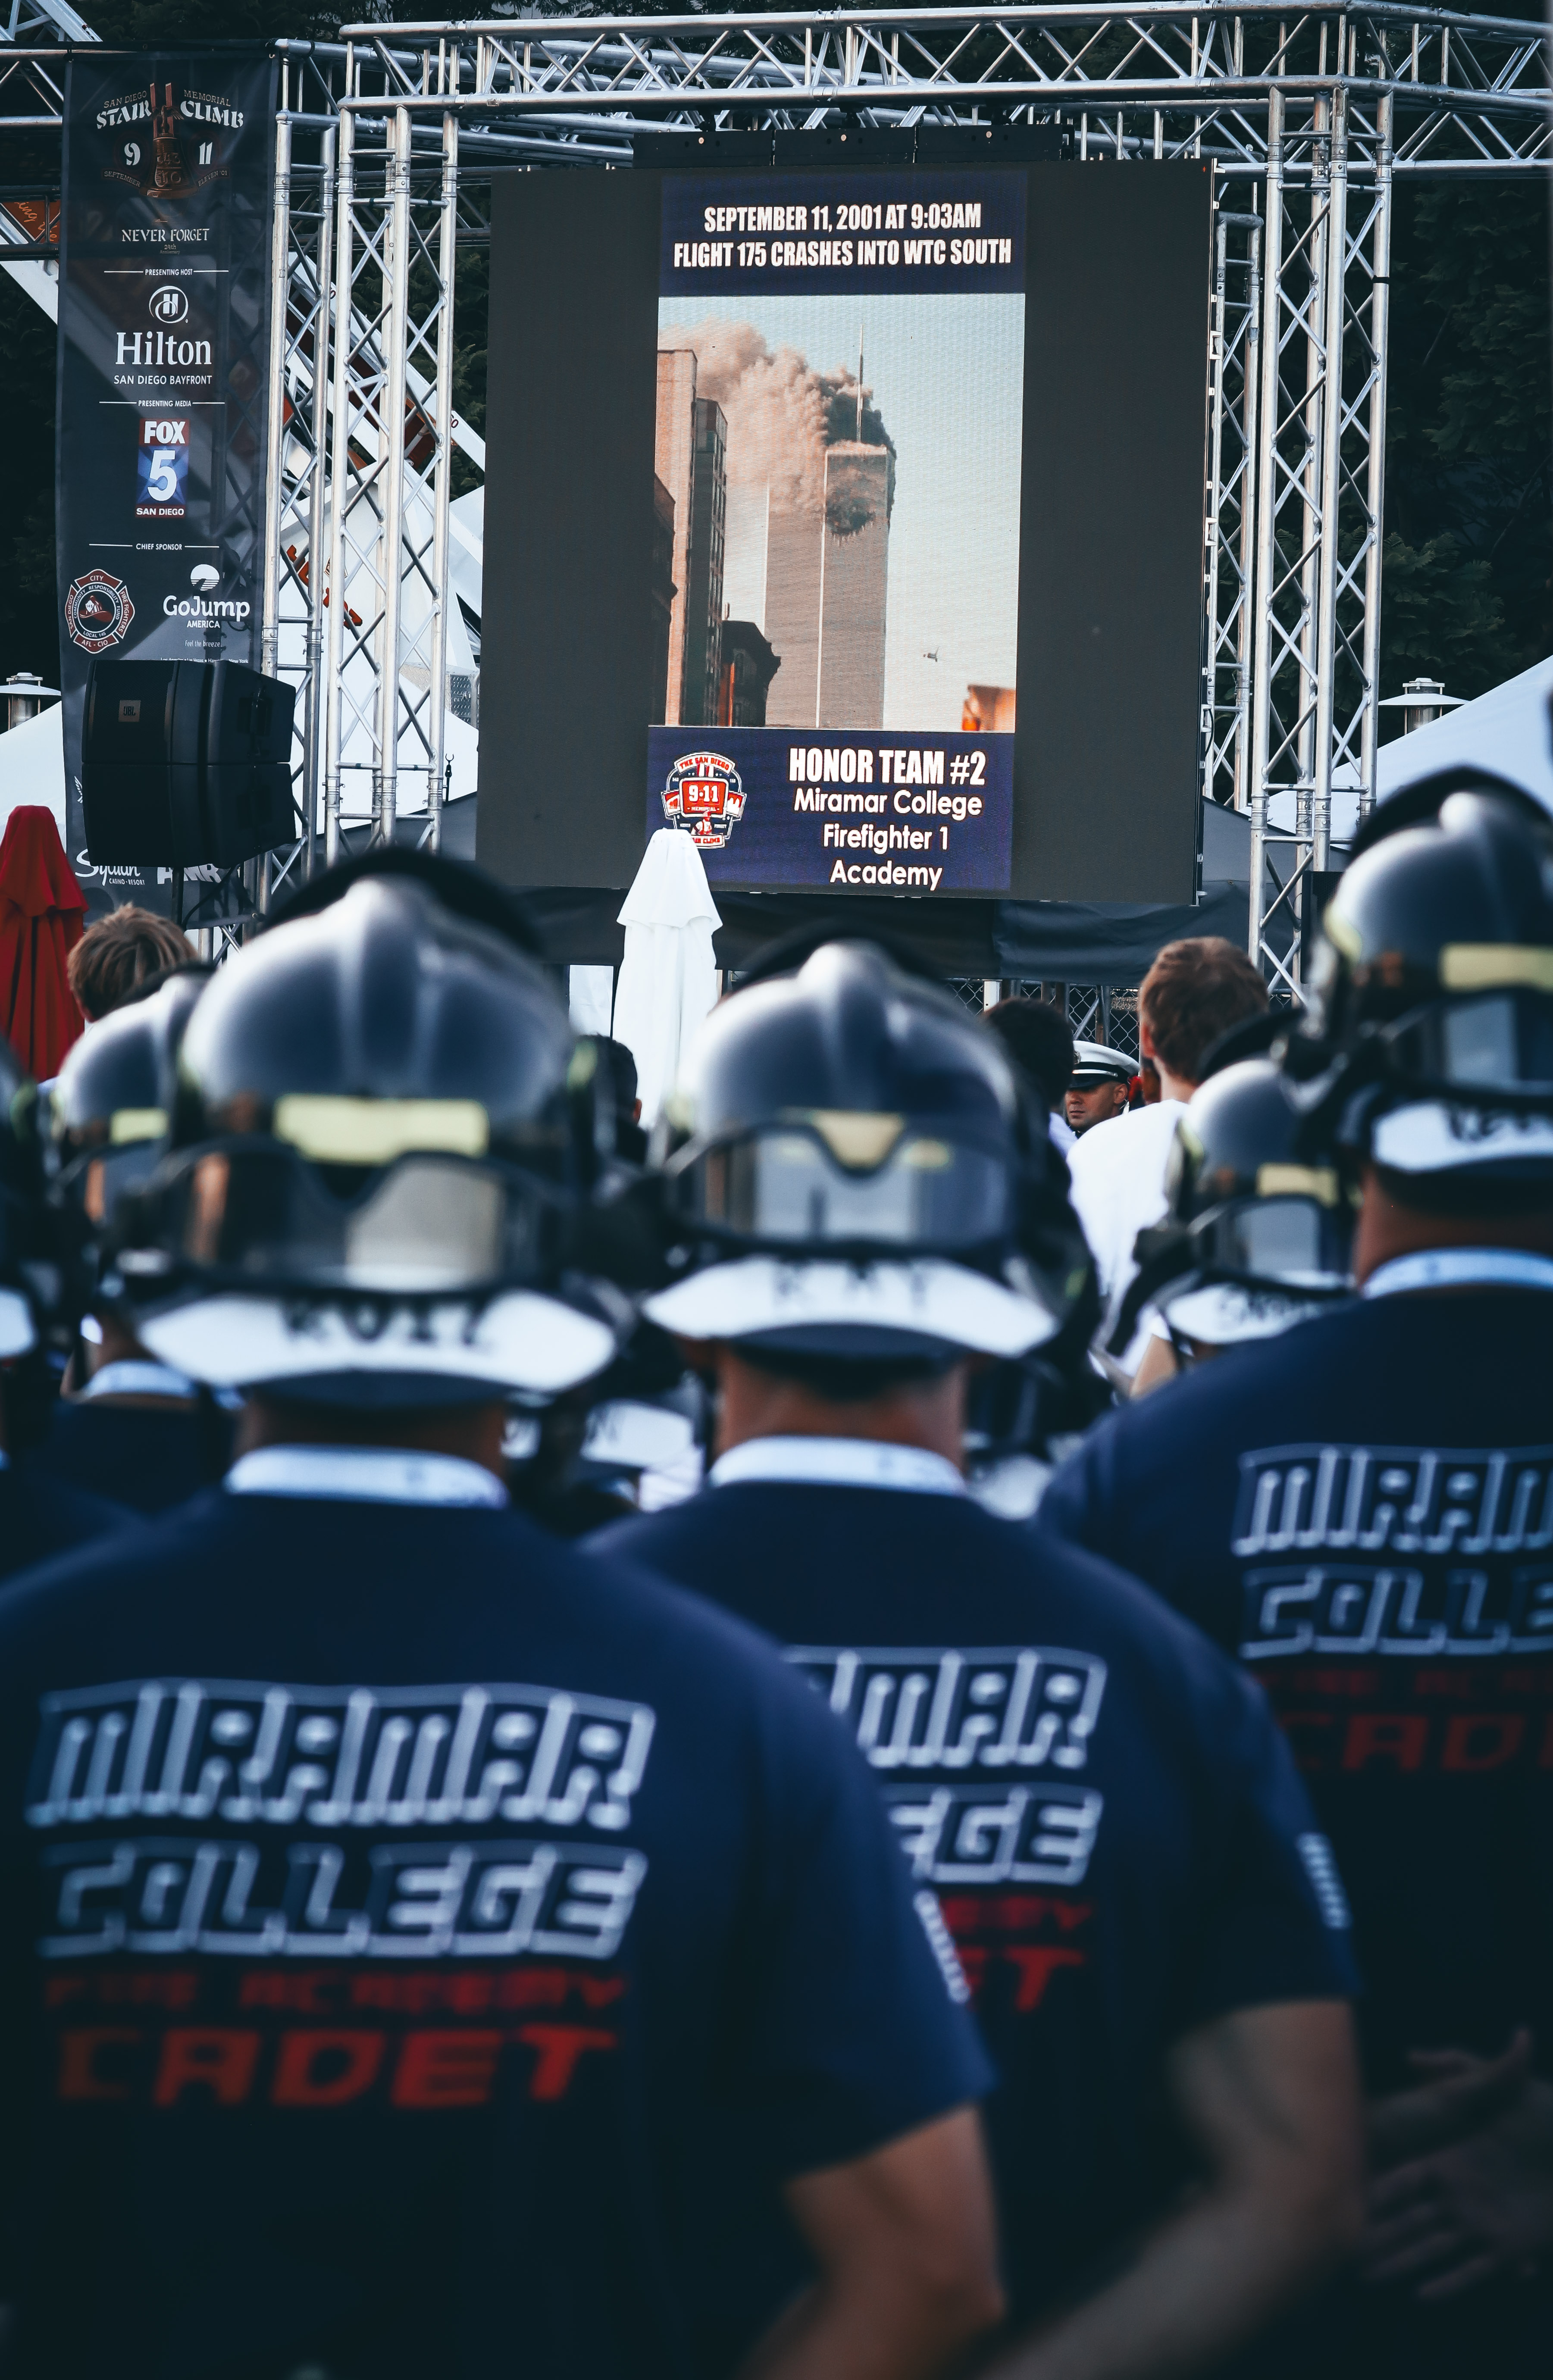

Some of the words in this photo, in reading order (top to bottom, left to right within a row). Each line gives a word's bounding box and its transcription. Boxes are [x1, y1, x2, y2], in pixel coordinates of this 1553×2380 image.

[104, 97, 122, 109] SAN
[124, 91, 147, 103] DIEGO
[184, 89, 231, 106] MEMORIAL
[96, 100, 152, 129] STAIR
[180, 100, 244, 128] CLIMB
[124, 143, 141, 166] 9
[199, 142, 213, 165] 11
[103, 171, 141, 187] SEPTEMBER
[198, 171, 219, 187] ELEVEN
[704, 206, 807, 232] SEPTEMBER
[811, 206, 832, 233] 11,
[836, 204, 882, 231] 2001
[885, 204, 907, 229] AT
[911, 203, 981, 229] 9:03AM
[121, 229, 167, 242] NEVER
[170, 228, 210, 241] FORGET
[674, 242, 734, 268] FLIGHT
[737, 242, 767, 267] 175
[771, 241, 853, 267] CRASHES
[857, 240, 899, 265] INTO
[904, 239, 946, 265] WTC
[950, 238, 1011, 265] SOUTH
[115, 331, 212, 365] Hilton
[113, 375, 135, 385] SAN
[137, 375, 167, 385] DIEGO
[170, 375, 213, 385] BAYFRONT
[144, 420, 186, 444] FOX
[147, 450, 177, 502] 5
[136, 507, 157, 516] SAN
[159, 507, 185, 516] DIEGO
[74, 589, 86, 619] COMMUNITY
[88, 585, 119, 604] RESPONSIBILITY
[163, 595, 250, 622] GoJump
[186, 620, 220, 629] AMERICA
[123, 706, 136, 716] JBL
[789, 747, 873, 783] HONOR
[879, 750, 944, 785] TEAM
[950, 751, 986, 785] #2
[794, 788, 888, 814] Miramar
[894, 790, 982, 821] College
[824, 823, 933, 854] Firefighter
[939, 826, 948, 850] 1
[830, 860, 942, 891] Academy
[1232, 1442, 1553, 1556] MIRAM
[1238, 1564, 1553, 1660] COLLE
[25, 1677, 655, 1830] MIRAMAR
[36, 1837, 648, 1959] COLLEGE
[56, 2023, 617, 2108] CADET
